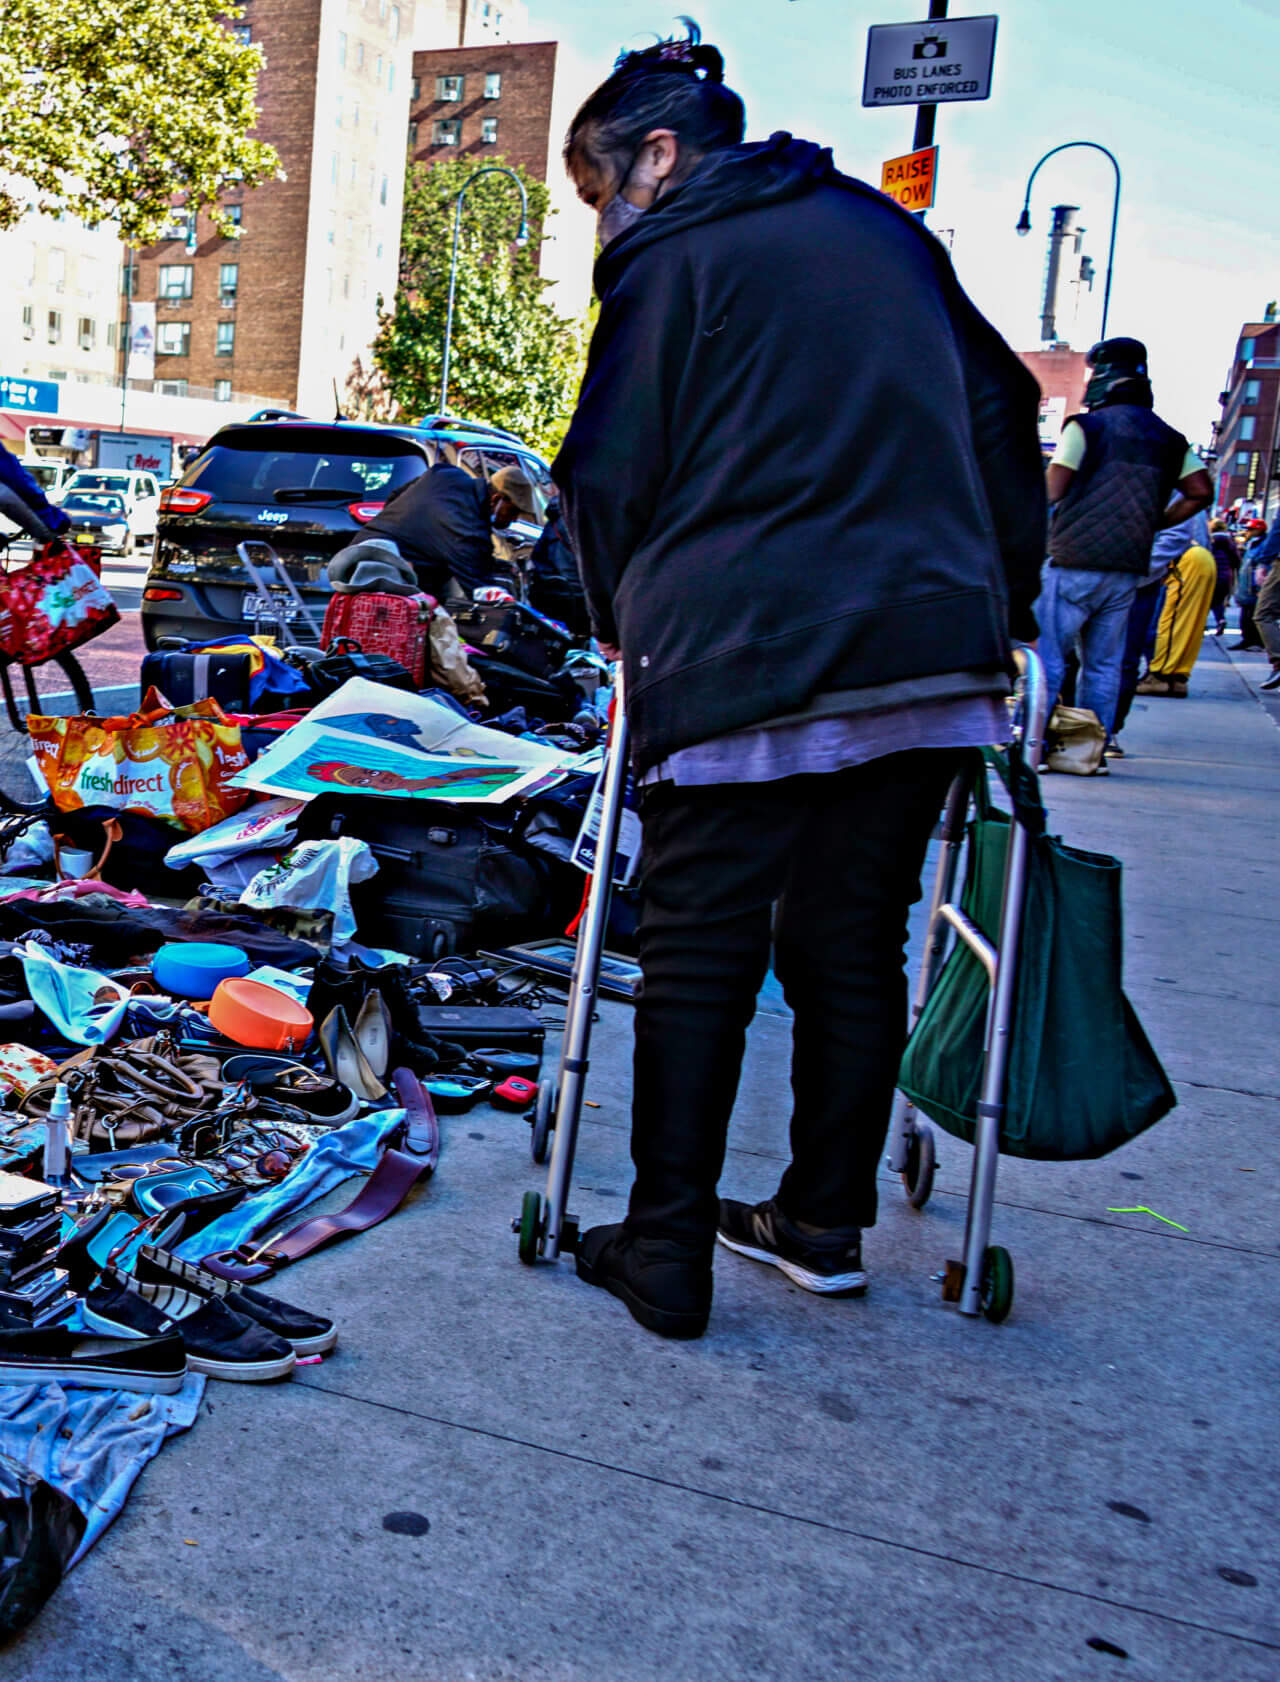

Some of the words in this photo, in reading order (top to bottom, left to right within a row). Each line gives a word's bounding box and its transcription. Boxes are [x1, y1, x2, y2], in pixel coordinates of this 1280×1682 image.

[893, 67, 918, 80] BUS
[922, 64, 962, 79] LANES
[873, 85, 913, 99] PHOTO
[916, 80, 980, 97] ENFORCED
[885, 157, 931, 186] RAISE
[134, 453, 162, 470] Ryder
[257, 509, 289, 523] Jeep
[81, 767, 165, 795] freshdirect
